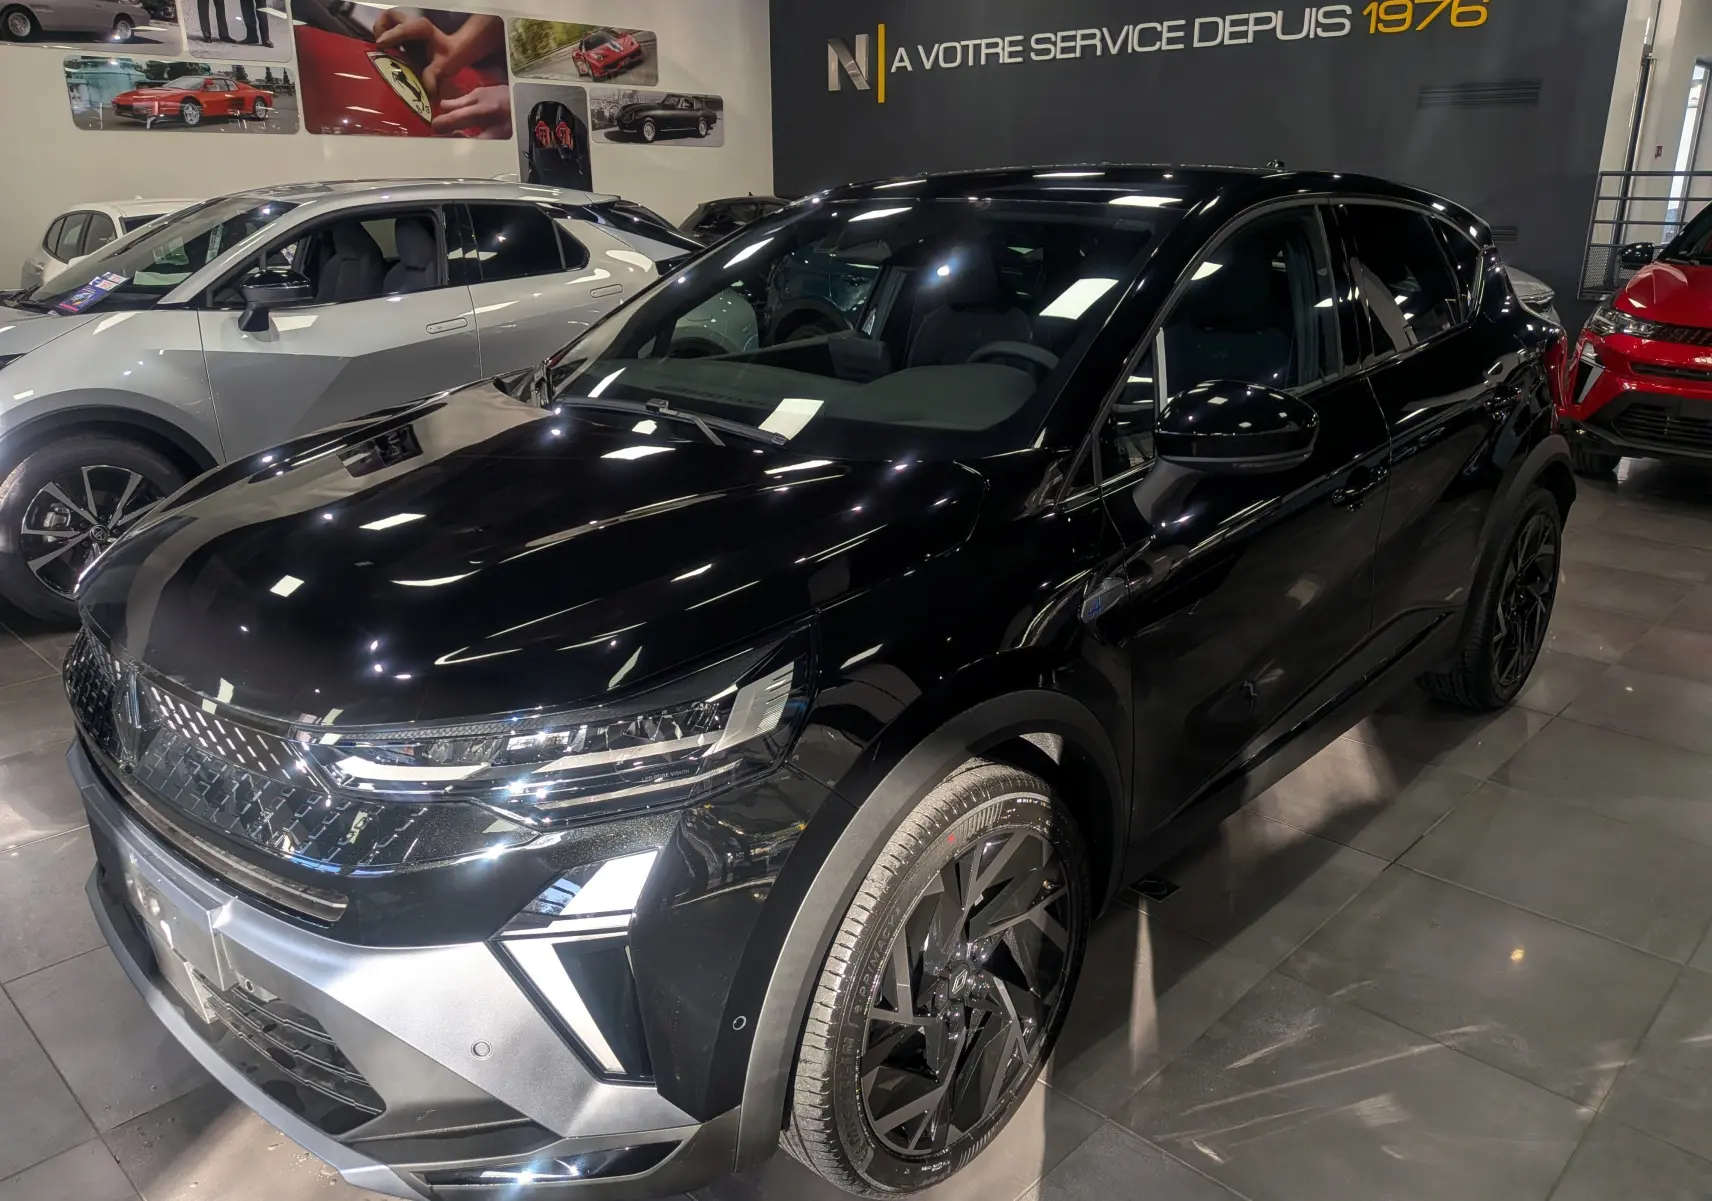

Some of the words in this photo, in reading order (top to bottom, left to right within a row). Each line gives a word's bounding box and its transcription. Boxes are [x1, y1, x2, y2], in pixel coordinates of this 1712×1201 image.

[890, 46, 914, 74] A
[916, 34, 1025, 71] VOTRE
[1029, 18, 1187, 62] SERVICE
[1192, 3, 1354, 49] DEPUIS
[1361, 0, 1488, 35] 1976
[669, 768, 690, 777] VISION
